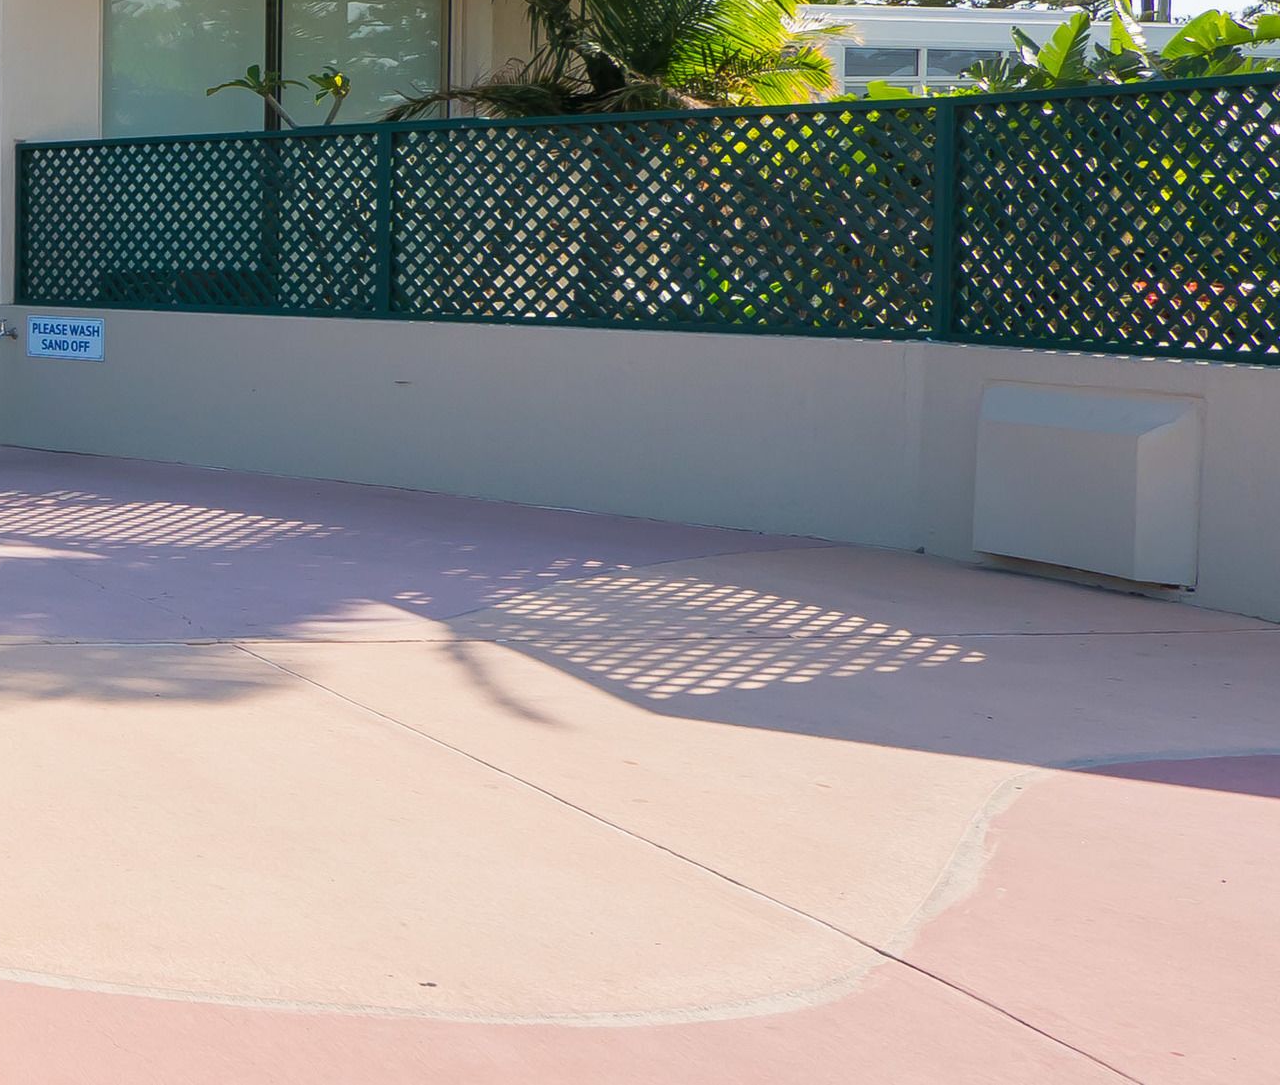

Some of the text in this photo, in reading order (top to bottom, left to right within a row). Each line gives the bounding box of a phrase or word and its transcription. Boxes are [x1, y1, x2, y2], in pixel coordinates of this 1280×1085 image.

[32, 323, 100, 337] PLEASE WASH
[41, 339, 90, 352] SAND OFF
